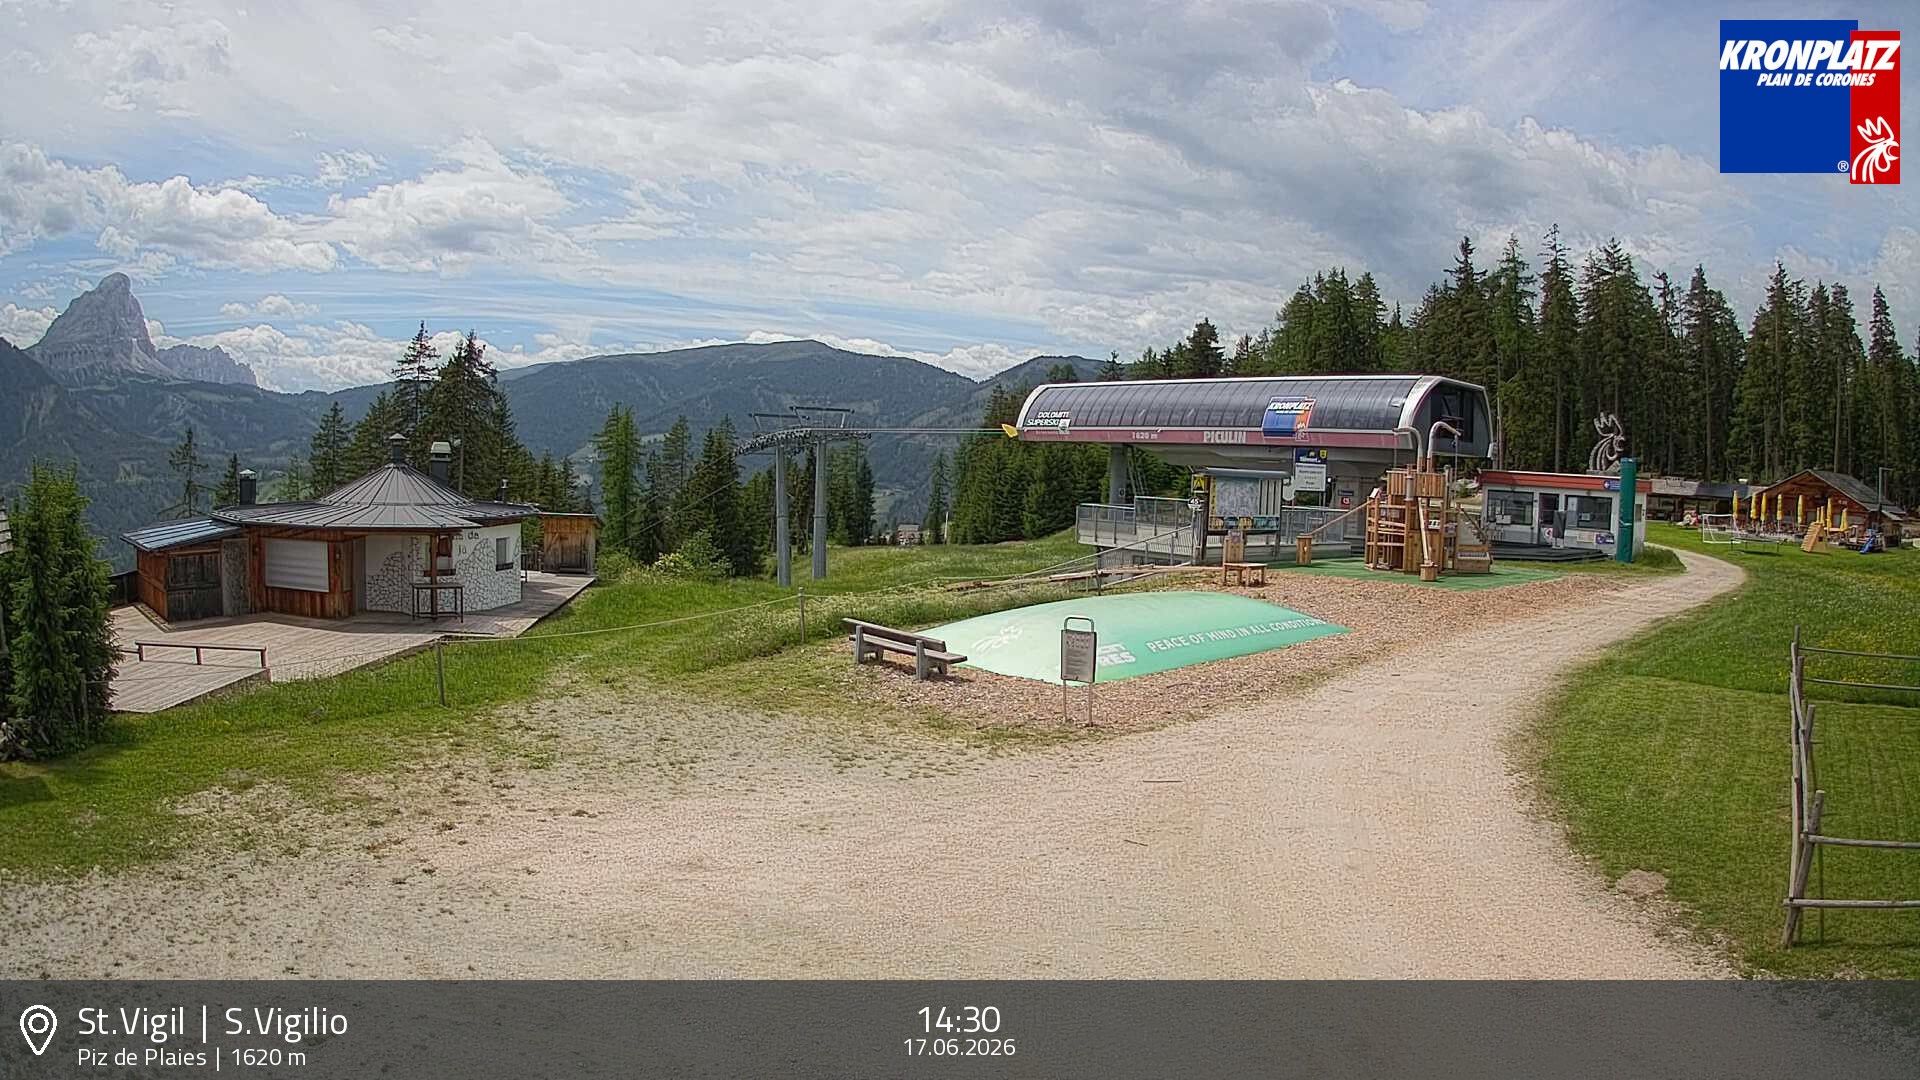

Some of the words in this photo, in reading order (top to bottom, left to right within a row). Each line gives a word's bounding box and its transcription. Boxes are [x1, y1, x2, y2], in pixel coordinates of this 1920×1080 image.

[1203, 431, 1246, 444] PICULIN
[1146, 636, 1189, 652] PEACE
[1191, 633, 1209, 644] OF
[1206, 628, 1237, 642] MIND
[1235, 626, 1251, 637] IN
[1250, 623, 1272, 634] ALL
